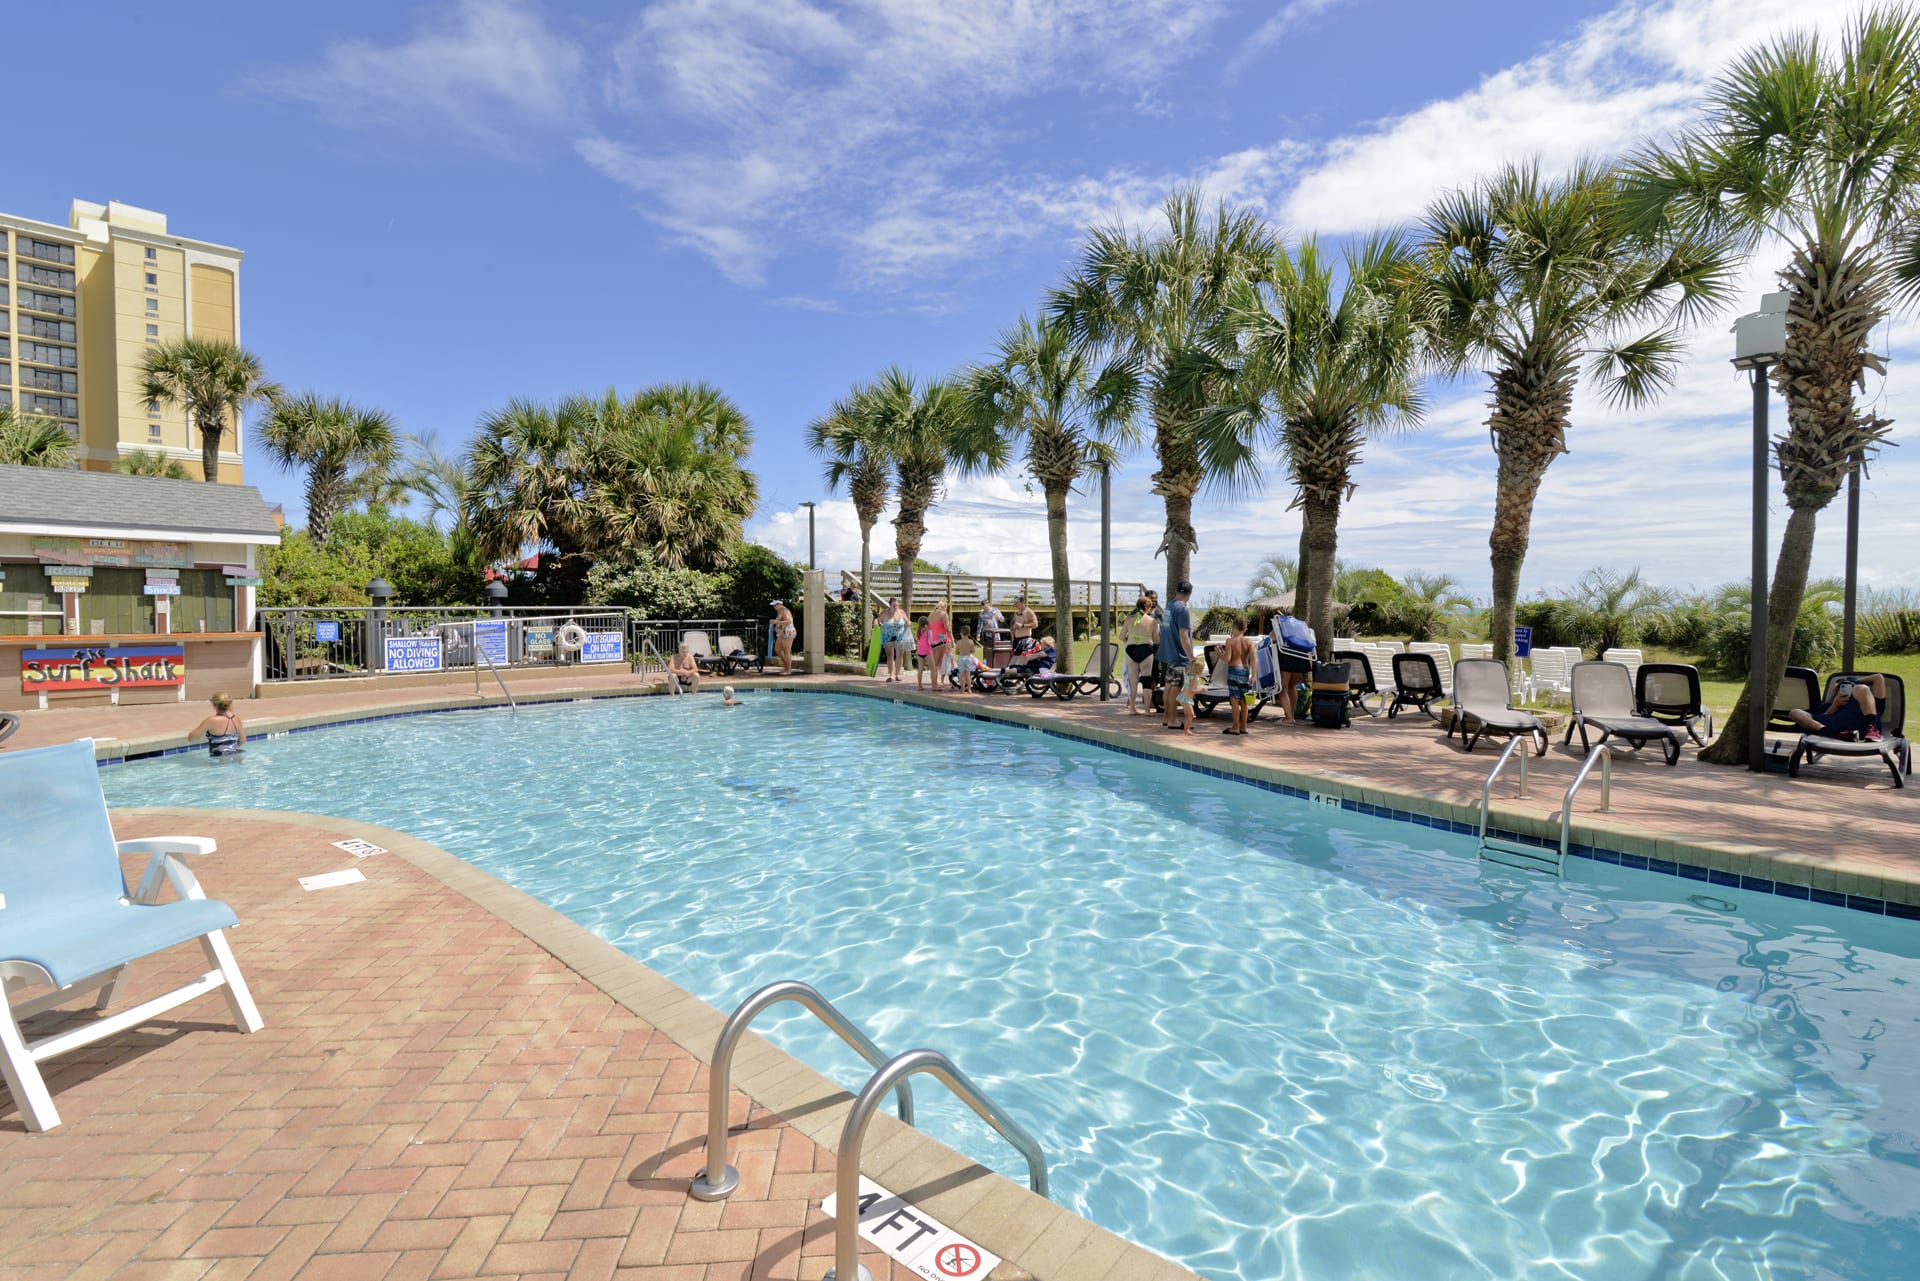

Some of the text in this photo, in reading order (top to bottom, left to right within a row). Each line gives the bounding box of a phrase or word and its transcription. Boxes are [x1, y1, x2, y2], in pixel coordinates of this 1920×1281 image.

[535, 632, 546, 640] NO
[593, 634, 621, 643] LIFEGUARD
[389, 639, 438, 648] SHALLOW WATER
[591, 643, 614, 653] ON DUTY
[73, 648, 106, 662] the
[389, 647, 438, 659] NO DIVING
[393, 658, 435, 669] ALLOWED
[26, 657, 178, 684] Surf Shack
[1326, 796, 1340, 807] FT
[870, 1208, 939, 1252] FT
[918, 1265, 930, 1274] NO
